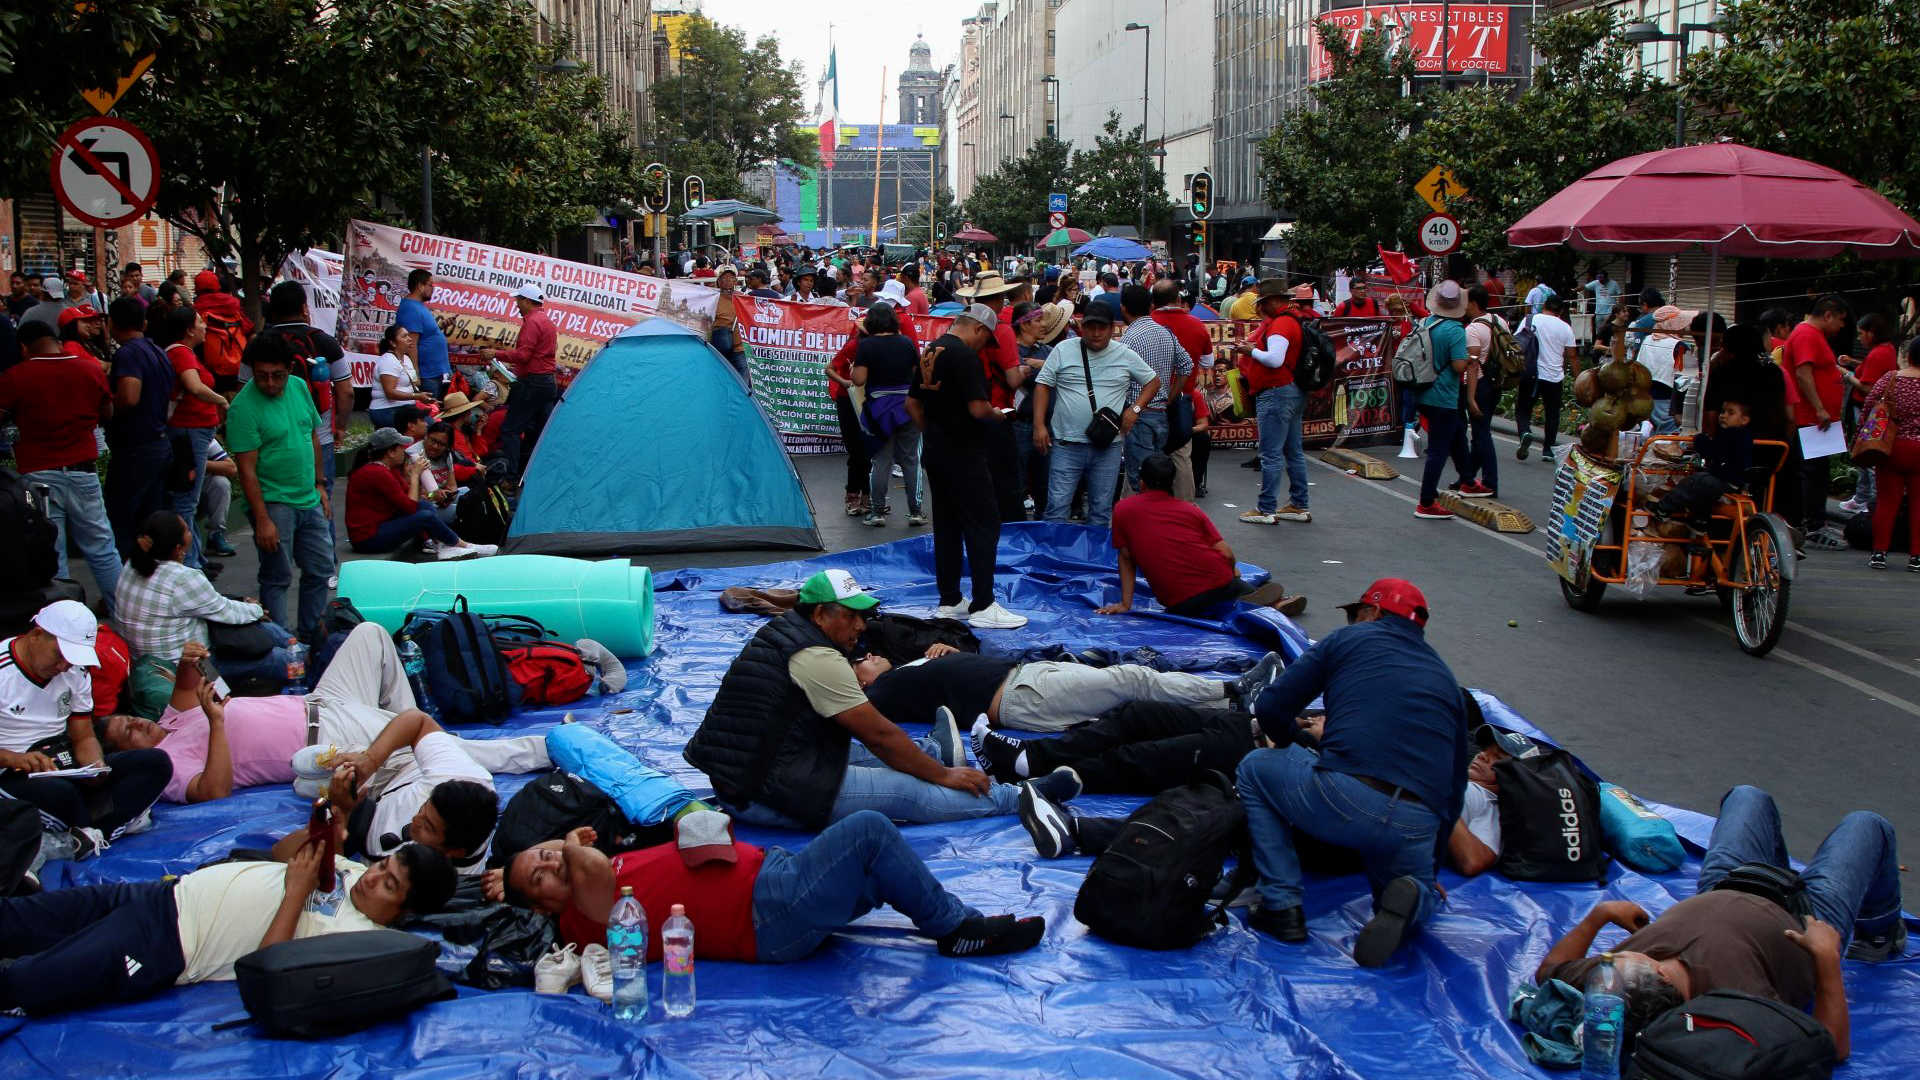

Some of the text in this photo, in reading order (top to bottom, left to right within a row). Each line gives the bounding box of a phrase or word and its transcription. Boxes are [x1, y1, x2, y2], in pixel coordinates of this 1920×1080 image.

[1451, 61, 1458, 69] Y
[1460, 60, 1501, 70] COCTEL
[1428, 223, 1449, 236] 40
[1428, 238, 1449, 246] km/h
[400, 232, 464, 261] COMITÉ
[466, 246, 487, 266] DE
[493, 252, 546, 278] LUCHA
[551, 263, 657, 301] CUAUHTEPEC
[435, 262, 485, 283] ESCUELA
[545, 283, 628, 313] QUETZALCOATL
[349, 308, 397, 325] CNTE
[430, 285, 508, 316] BROGACIÓN
[570, 313, 588, 333] DEL
[350, 331, 384, 339] DEMOCRÁTI
[474, 324, 493, 341] DE
[738, 321, 749, 340] EL
[750, 326, 803, 348] COMITÉ
[805, 332, 829, 351] DE
[560, 343, 598, 364] SALA
[751, 346, 773, 360] XIGE
[773, 347, 820, 364] SOLUCIÓN
[794, 365, 802, 374] A
[803, 366, 815, 376] LA
[1346, 356, 1384, 371] CNTE
[793, 376, 806, 386] DE
[807, 378, 819, 387] LA
[775, 387, 831, 400] PEÑA-AMLO-
[1348, 387, 1388, 411] 1989
[776, 397, 819, 410] SALARIAL
[821, 402, 837, 411] DEL
[805, 412, 817, 421] DE
[1303, 421, 1336, 435] EMOS
[1558, 787, 1581, 862] adidas
